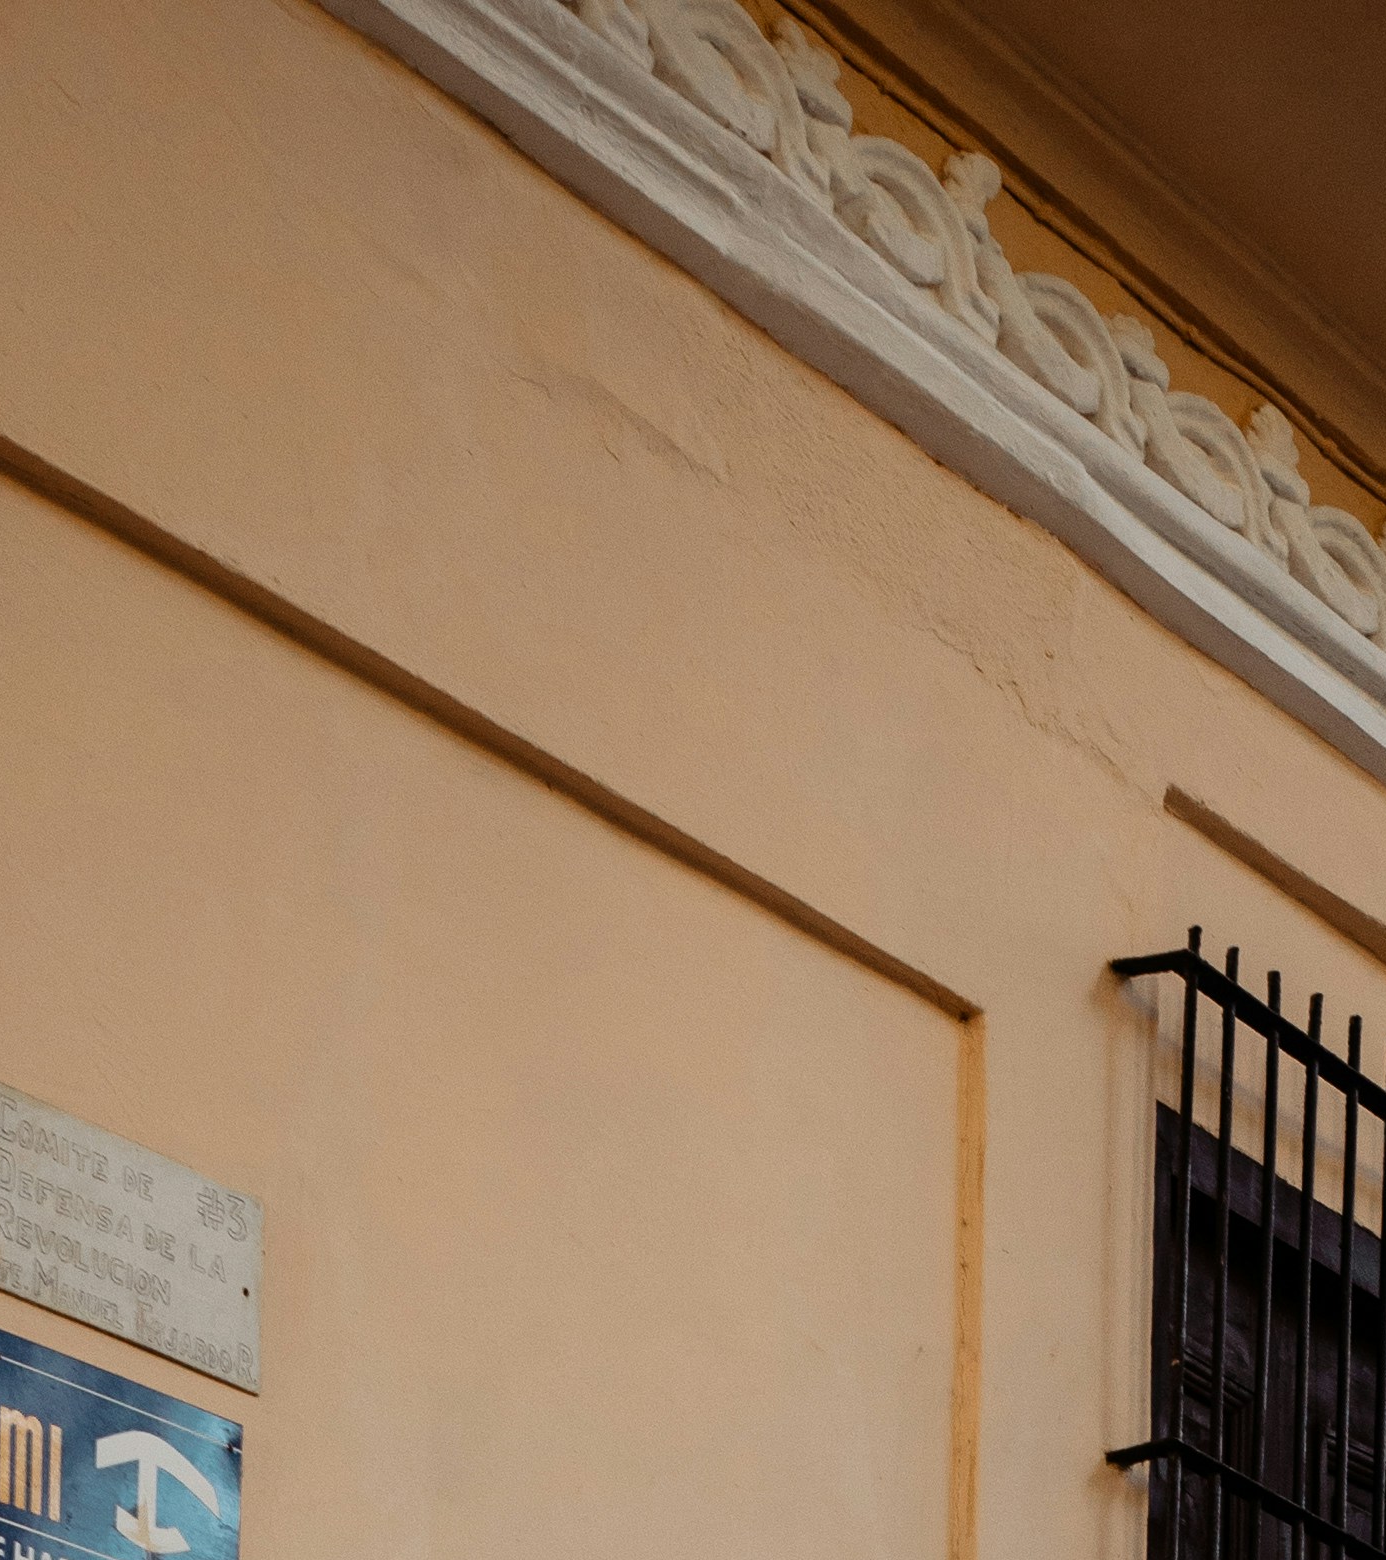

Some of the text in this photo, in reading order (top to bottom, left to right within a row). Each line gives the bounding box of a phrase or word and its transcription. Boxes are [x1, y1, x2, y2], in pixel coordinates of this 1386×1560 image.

[123, 1165, 154, 1202] DE
[196, 1186, 248, 1242] #3
[143, 1223, 176, 1263] DE
[188, 1242, 228, 1284] LA
[34, 1257, 124, 1331] MANUEL
